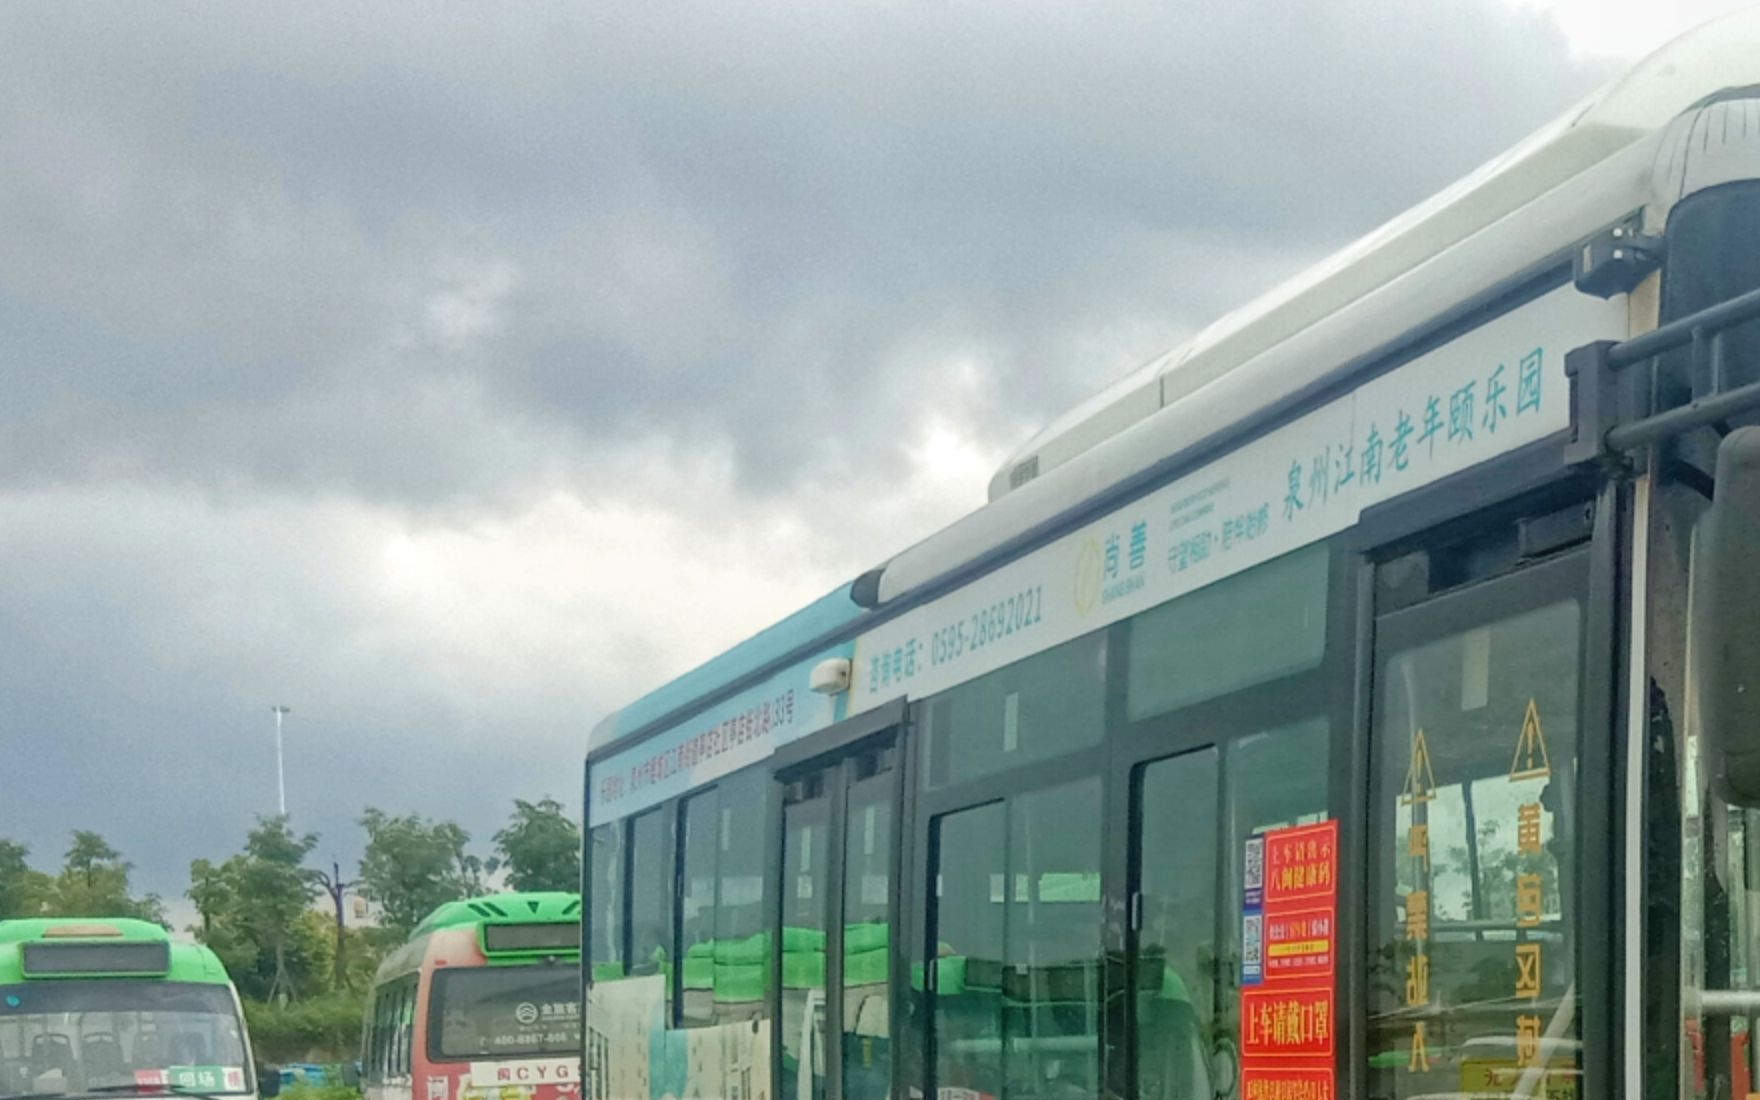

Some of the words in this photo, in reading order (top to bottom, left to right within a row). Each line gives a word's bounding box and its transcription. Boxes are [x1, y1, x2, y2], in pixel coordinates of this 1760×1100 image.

[1281, 346, 1545, 521] 泉州江南老年颐乐园
[1246, 1000, 1329, 1046] 上车请戴口罩
[497, 1064, 582, 1081] 闽CYG
